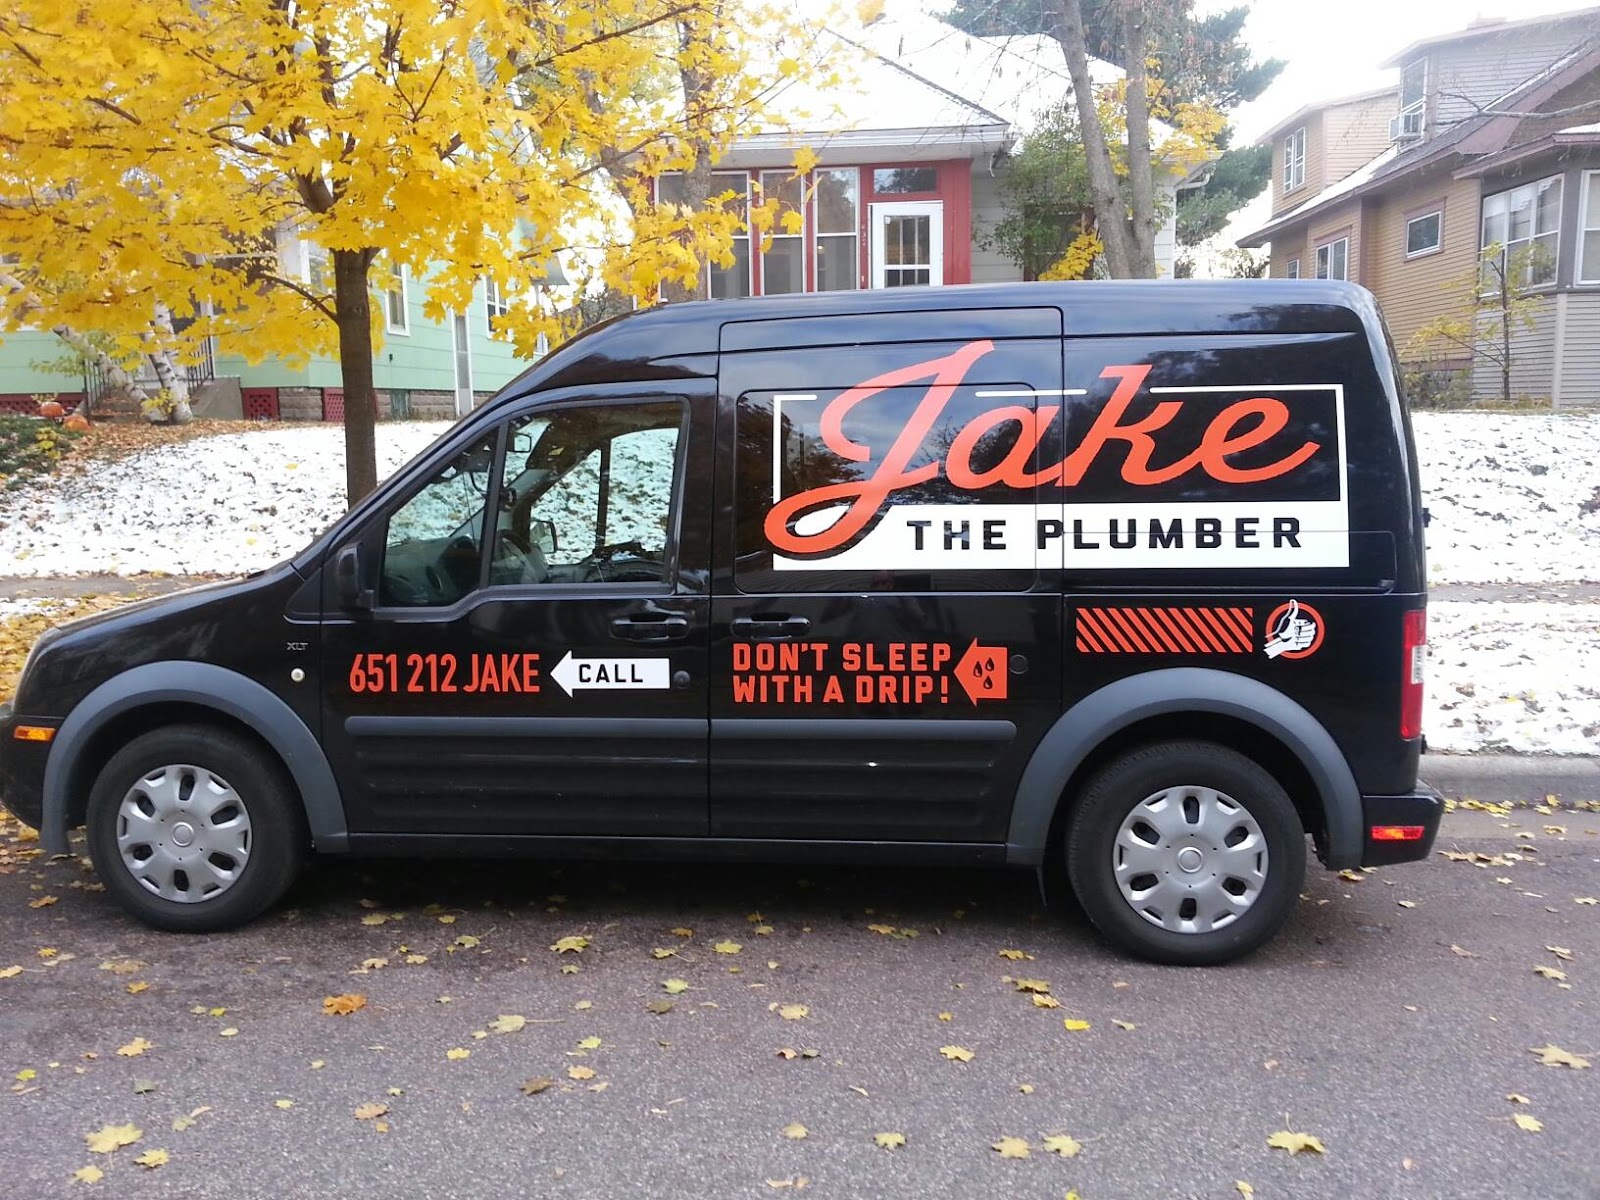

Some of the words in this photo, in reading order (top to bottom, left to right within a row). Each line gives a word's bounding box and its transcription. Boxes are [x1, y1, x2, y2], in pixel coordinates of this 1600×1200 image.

[764, 339, 1321, 557] Jake
[907, 520, 1007, 551] THE
[1037, 517, 1302, 550] PLUMBER
[286, 642, 308, 650] XLT
[732, 643, 829, 672] DON'T
[842, 643, 951, 672] SLEEP
[349, 654, 398, 692] 651
[406, 654, 456, 692] 212
[463, 653, 540, 692] JAKE
[578, 663, 644, 683] CALL
[732, 675, 813, 703] WITH
[822, 675, 845, 703] A
[855, 675, 949, 704] DRIP!
